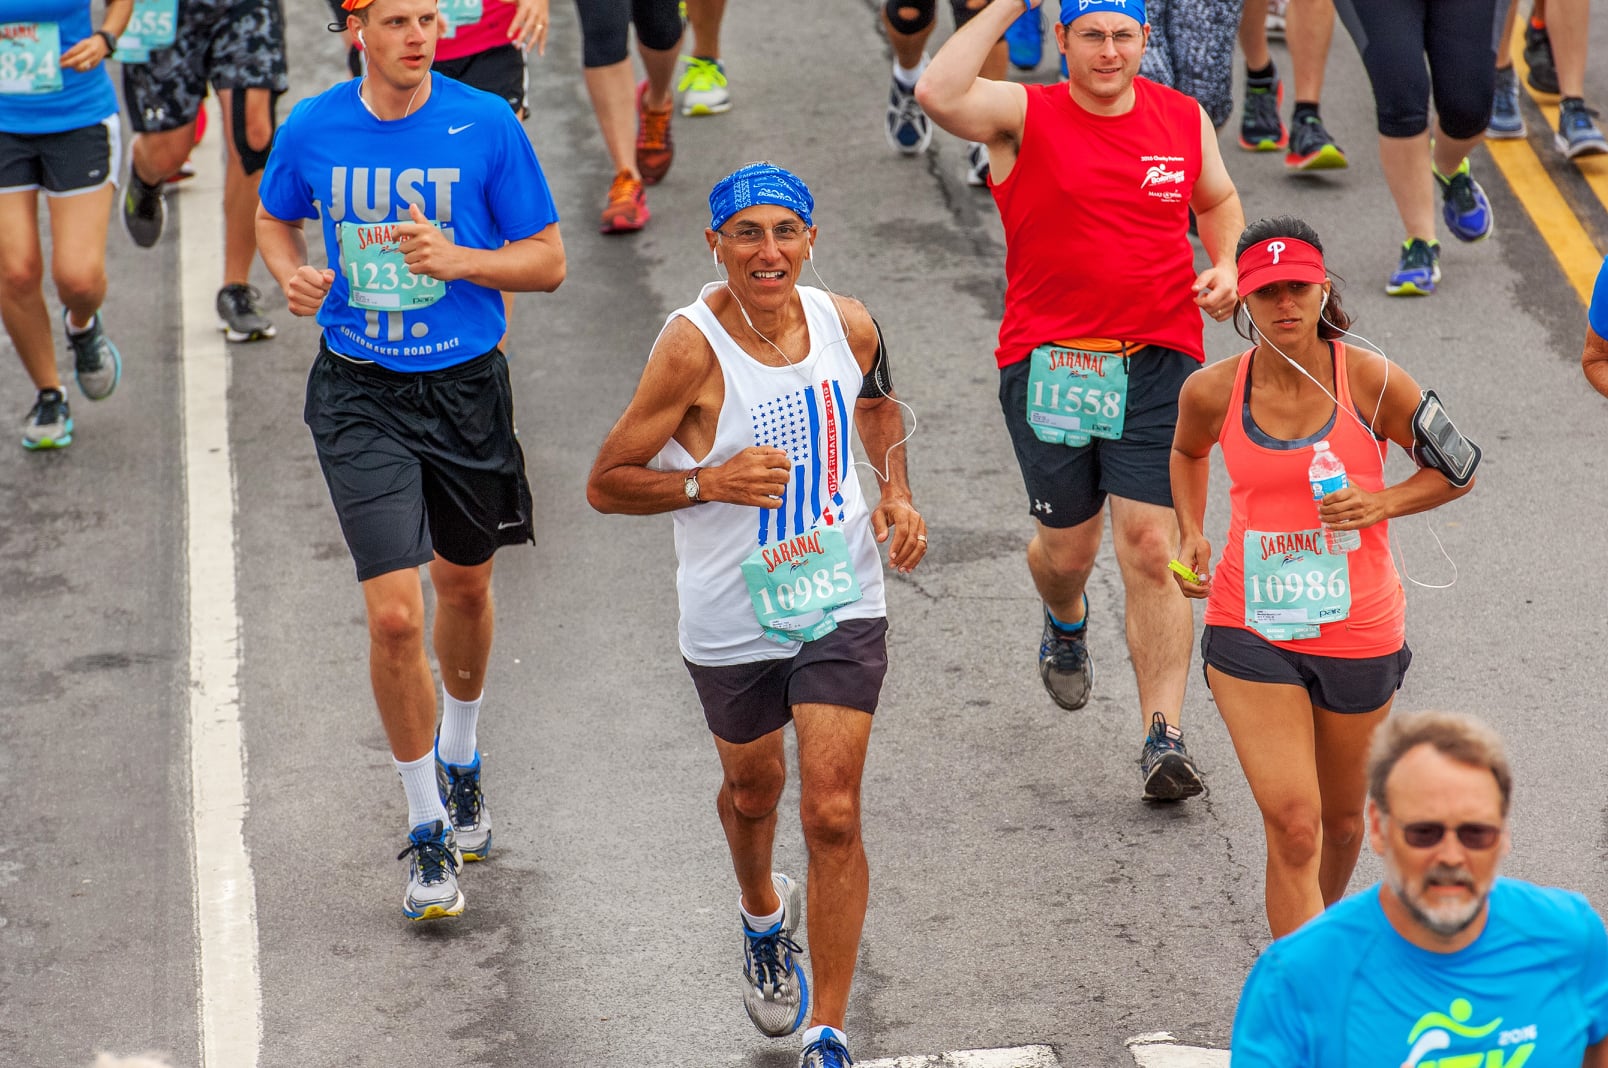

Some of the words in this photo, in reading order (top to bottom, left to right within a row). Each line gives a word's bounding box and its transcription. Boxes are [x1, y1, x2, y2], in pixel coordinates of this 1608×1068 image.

[0, 51, 57, 81] 824
[328, 166, 461, 223] JUST
[1267, 241, 1286, 265] P
[403, 345, 433, 356] ROAD
[436, 337, 460, 352] RACE
[1049, 349, 1107, 378] SARANAC
[1031, 380, 1122, 419] 11558
[762, 530, 825, 574] SARANAC
[1259, 531, 1323, 561] SARANAC
[758, 561, 853, 616] 10985
[1249, 567, 1347, 604] 10986
